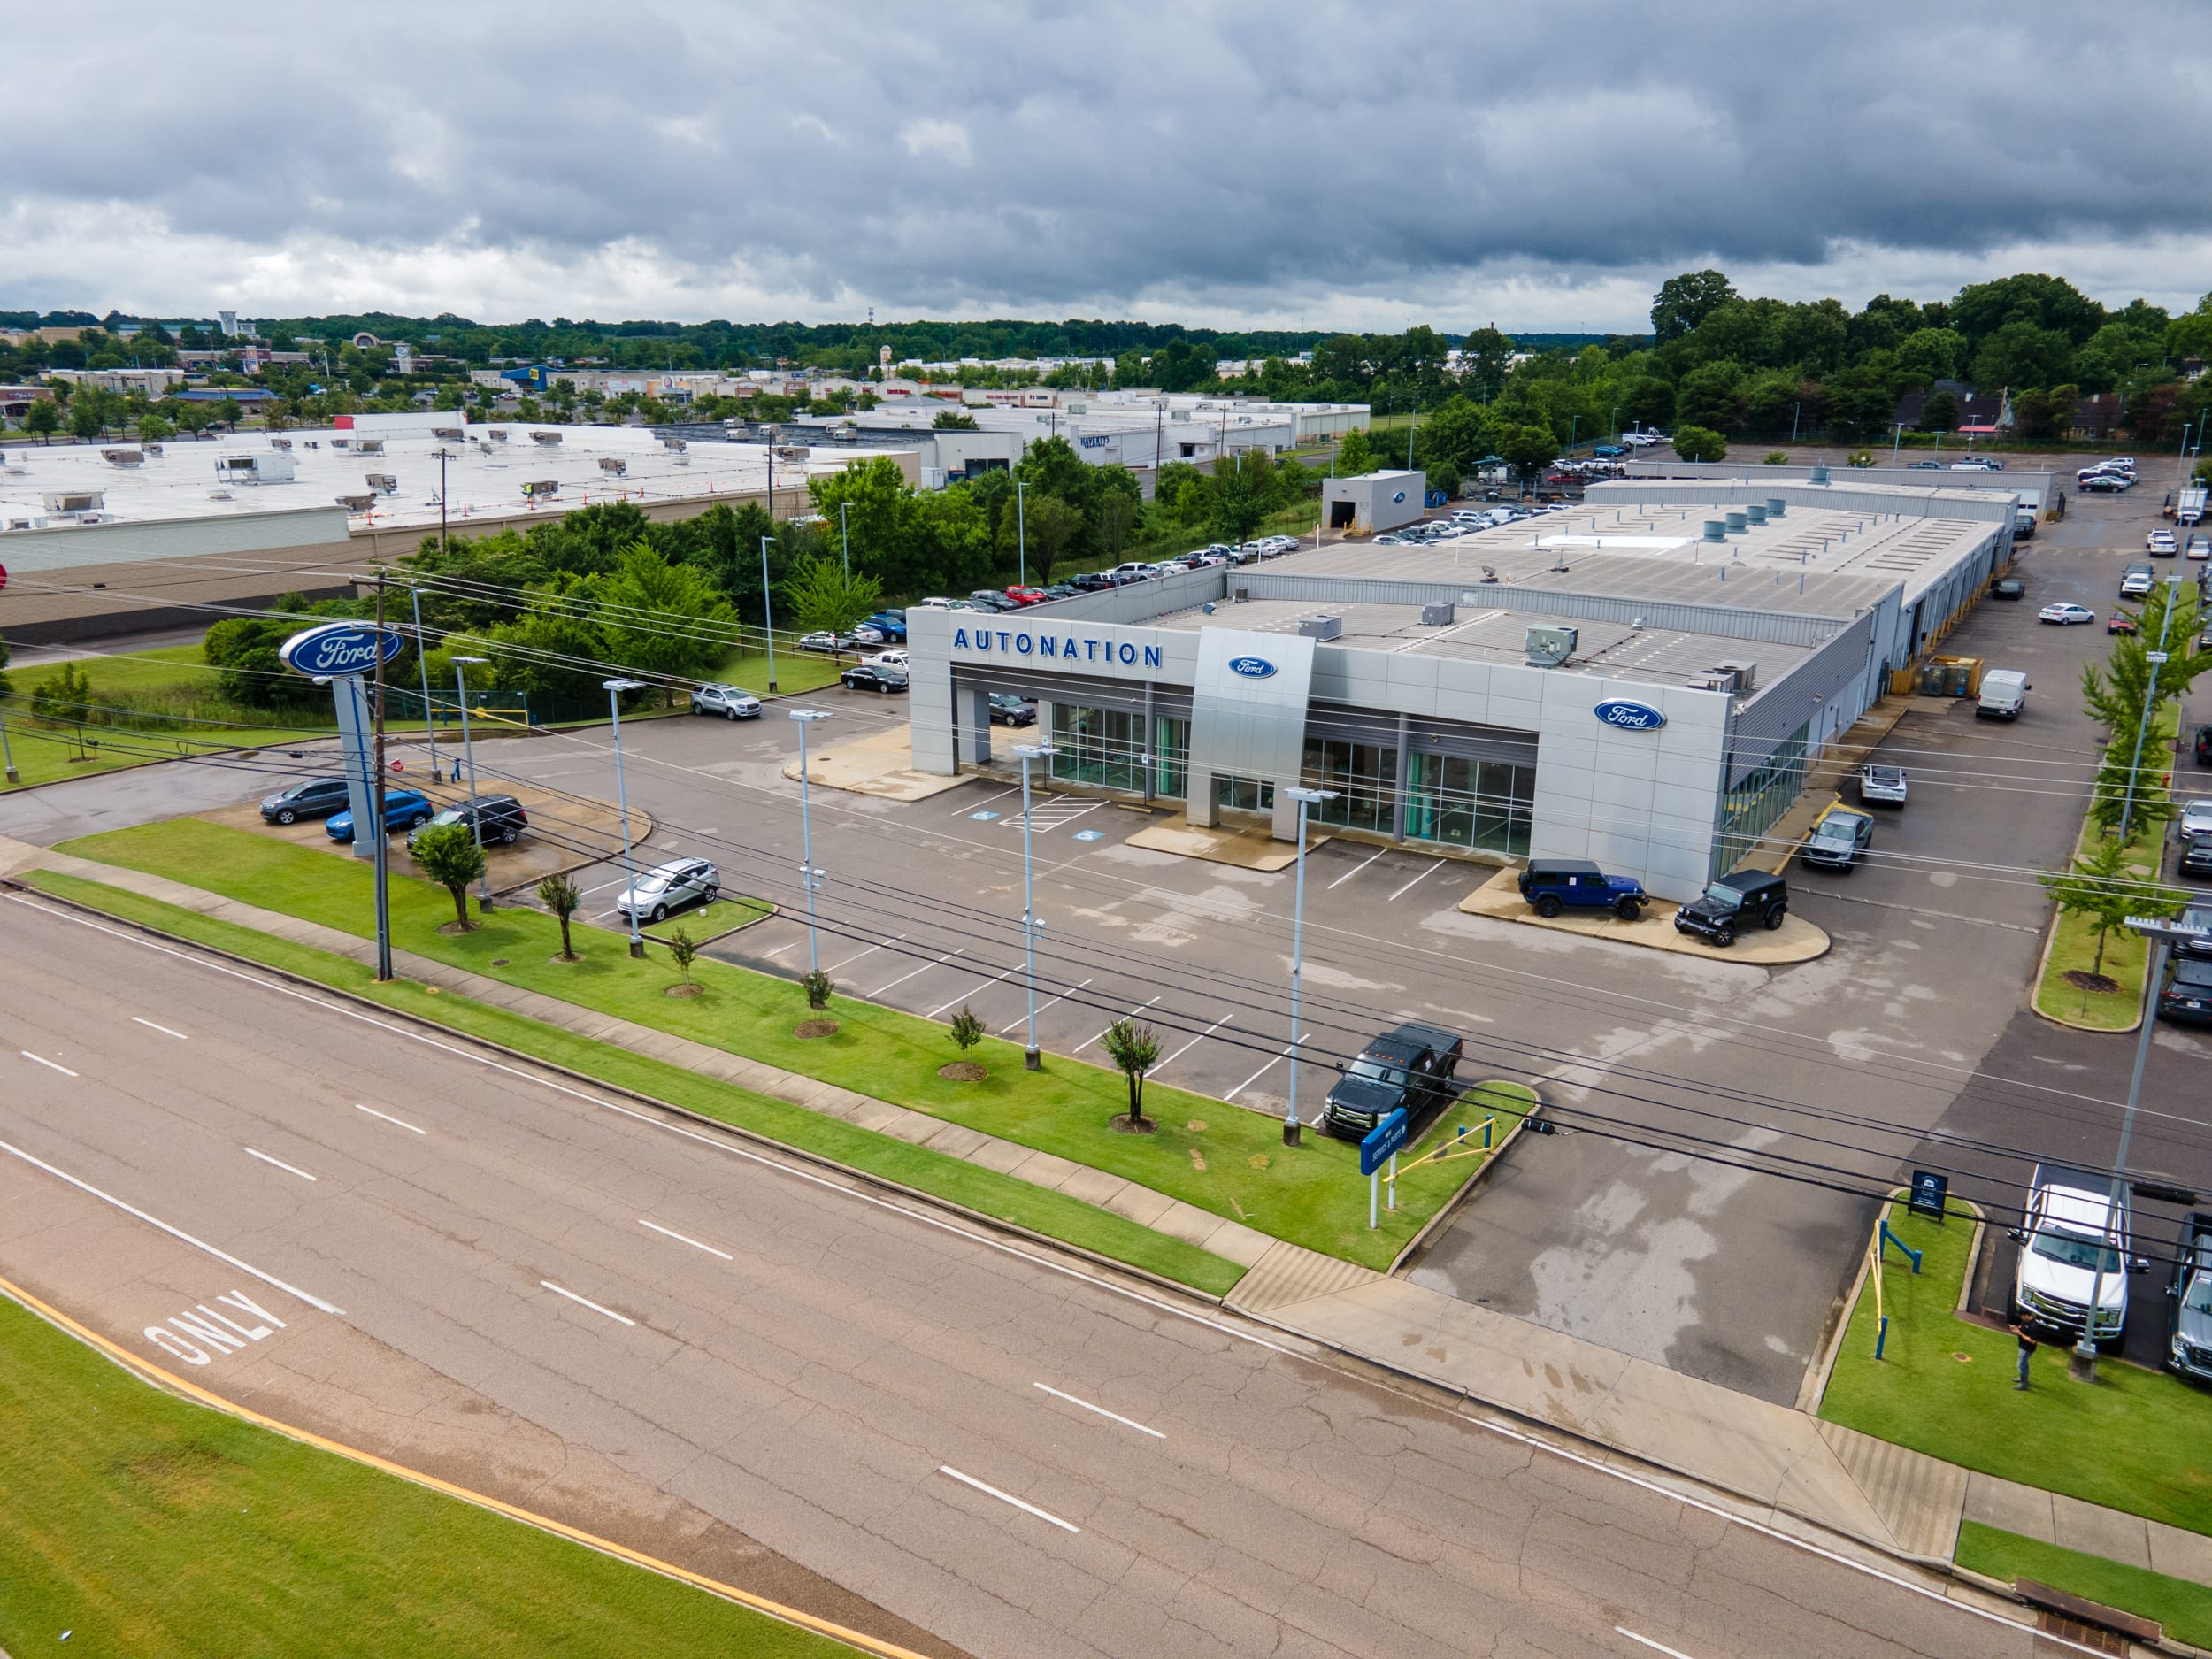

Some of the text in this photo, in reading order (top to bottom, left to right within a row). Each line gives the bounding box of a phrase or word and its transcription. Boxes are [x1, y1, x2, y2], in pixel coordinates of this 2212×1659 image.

[316, 634, 380, 668] Ford
[954, 628, 1162, 668] AUTONATION
[1237, 659, 1264, 674] Ford
[1607, 705, 1648, 726] Ford
[1372, 1141, 1388, 1162] SERVICE
[1390, 1128, 1402, 1145] PARTS
[143, 1288, 288, 1365] ONLY
